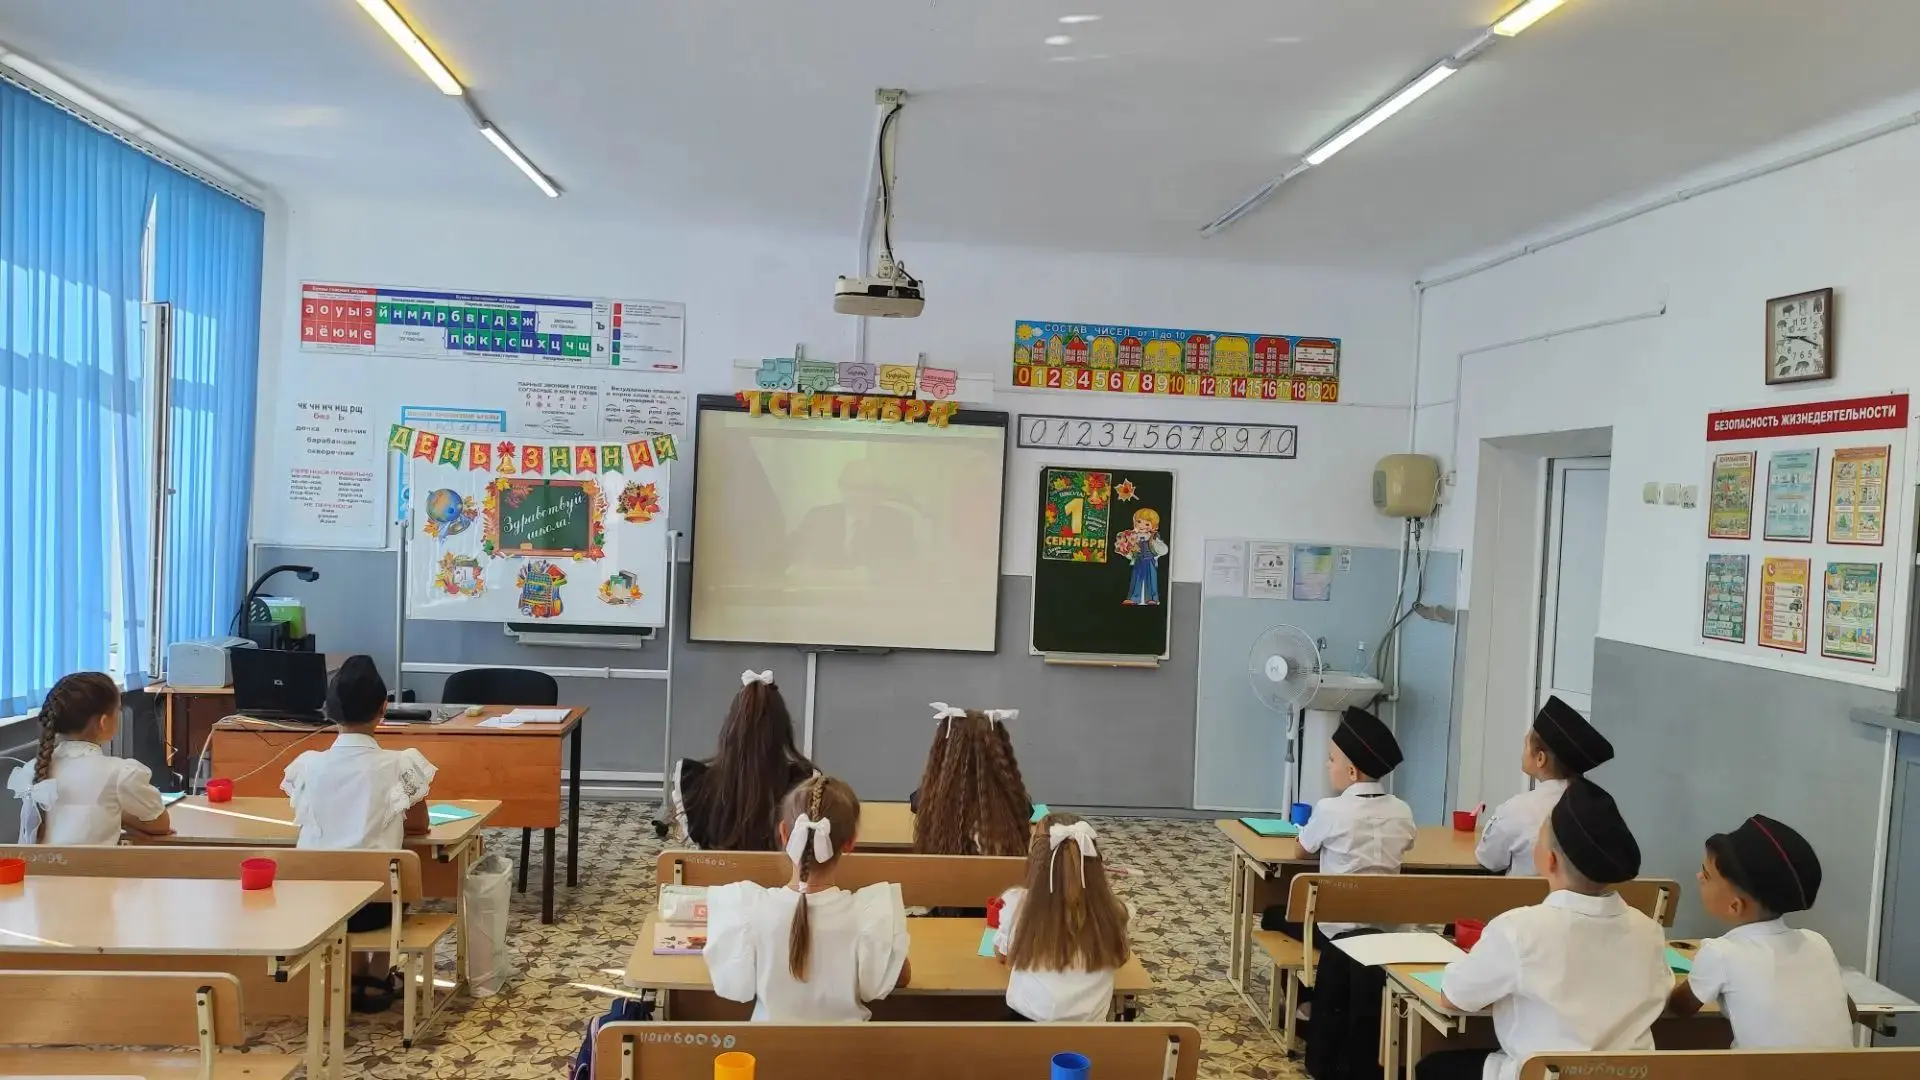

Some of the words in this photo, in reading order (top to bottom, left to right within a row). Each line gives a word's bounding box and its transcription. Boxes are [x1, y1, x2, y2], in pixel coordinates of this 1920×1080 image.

[305, 304, 314, 314] а
[320, 305, 329, 315] о
[336, 305, 344, 317] у
[349, 306, 360, 316] ы
[364, 307, 373, 317] э
[380, 306, 388, 317] й
[394, 310, 402, 319] н
[407, 310, 417, 319] м
[421, 311, 431, 320] л
[437, 312, 445, 323] р
[451, 310, 460, 322] б
[466, 313, 474, 323] в
[481, 314, 488, 323] г
[494, 316, 504, 326] д
[510, 316, 517, 326] з
[522, 317, 534, 326] ж
[305, 326, 314, 336] я
[320, 325, 329, 337] ё
[333, 328, 344, 337] ю
[349, 329, 358, 339] и
[364, 330, 372, 339] е
[451, 334, 459, 344] п
[464, 333, 475, 346] ф
[480, 336, 488, 345] к
[494, 338, 502, 346] т
[509, 338, 516, 347] с
[521, 339, 533, 348] ш
[537, 339, 545, 348] х
[551, 340, 560, 350] ц
[566, 341, 573, 350] ч
[578, 342, 590, 352] щ
[597, 343, 604, 352] ь
[1044, 324, 1087, 334] СОСТАВ
[1094, 327, 1130, 336] ЧИСЕЛ
[1160, 332, 1172, 340] до
[1175, 331, 1185, 339] 10
[1019, 367, 1030, 384] 0
[1035, 368, 1043, 385] 1
[1048, 369, 1060, 386] 2
[1064, 370, 1075, 387] 3
[1078, 371, 1090, 387] 4
[1096, 372, 1106, 388] 5
[1111, 372, 1121, 389] 6
[1127, 374, 1137, 389] 7
[1142, 374, 1153, 391] 8
[1158, 375, 1168, 391] 9
[1170, 376, 1184, 392] 10
[1186, 377, 1198, 393] 11
[1201, 378, 1215, 394] 12
[1217, 379, 1231, 394] 13
[1233, 380, 1246, 396] 14
[1248, 380, 1261, 396] 15
[1263, 381, 1277, 397] 16
[1278, 382, 1291, 398] 17
[1293, 382, 1306, 398] 18
[1308, 383, 1321, 399] 19
[1322, 384, 1337, 400] 20
[768, 393, 950, 428] СЕНТЯБРЯ
[1714, 418, 1779, 431] БЕЗОПАСНОСТЬ
[1781, 405, 1896, 426] ЖИЗНЕДЕЯТЕЛЬНОСТИ
[390, 427, 487, 466] ДЕНЬ
[524, 435, 674, 469] ЗНАНИЙ
[1029, 419, 1047, 444] 0
[1057, 420, 1069, 445] 1
[1076, 421, 1092, 446] 2
[1098, 422, 1114, 448] 3
[1122, 423, 1136, 448] 4
[1143, 424, 1159, 449] 5
[1166, 425, 1182, 450] 6
[1189, 425, 1204, 450] 7
[1210, 426, 1227, 451] 8
[1233, 427, 1249, 452] 9
[1064, 498, 1084, 534] 1
[1046, 536, 1105, 548] СЕНТЯБРЯ
